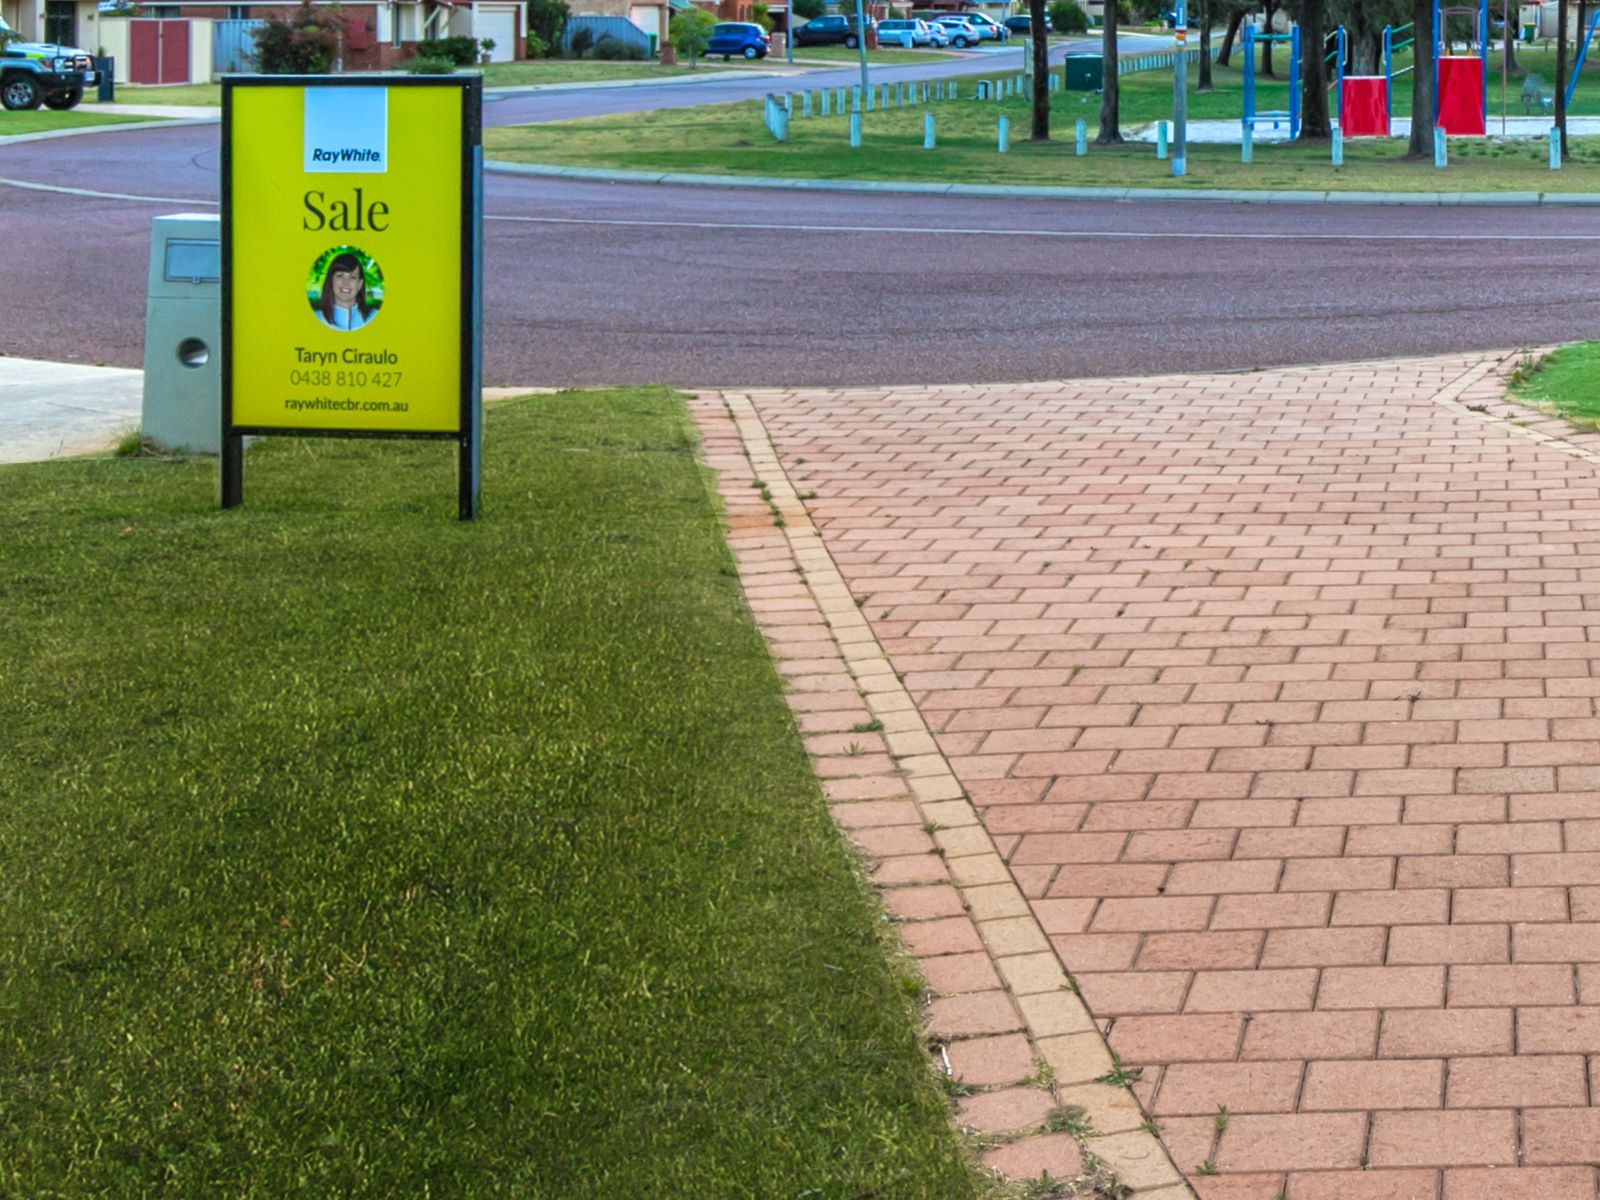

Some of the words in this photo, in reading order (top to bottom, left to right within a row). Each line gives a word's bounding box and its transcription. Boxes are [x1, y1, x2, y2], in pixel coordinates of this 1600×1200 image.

[303, 187, 389, 232] Sale
[294, 347, 338, 366] Taryn
[341, 348, 398, 365] Ciraulo
[290, 369, 331, 386] 0438
[336, 371, 367, 387] 810
[371, 371, 402, 388] 427
[285, 397, 409, 412] raywhitecbr.com.au
